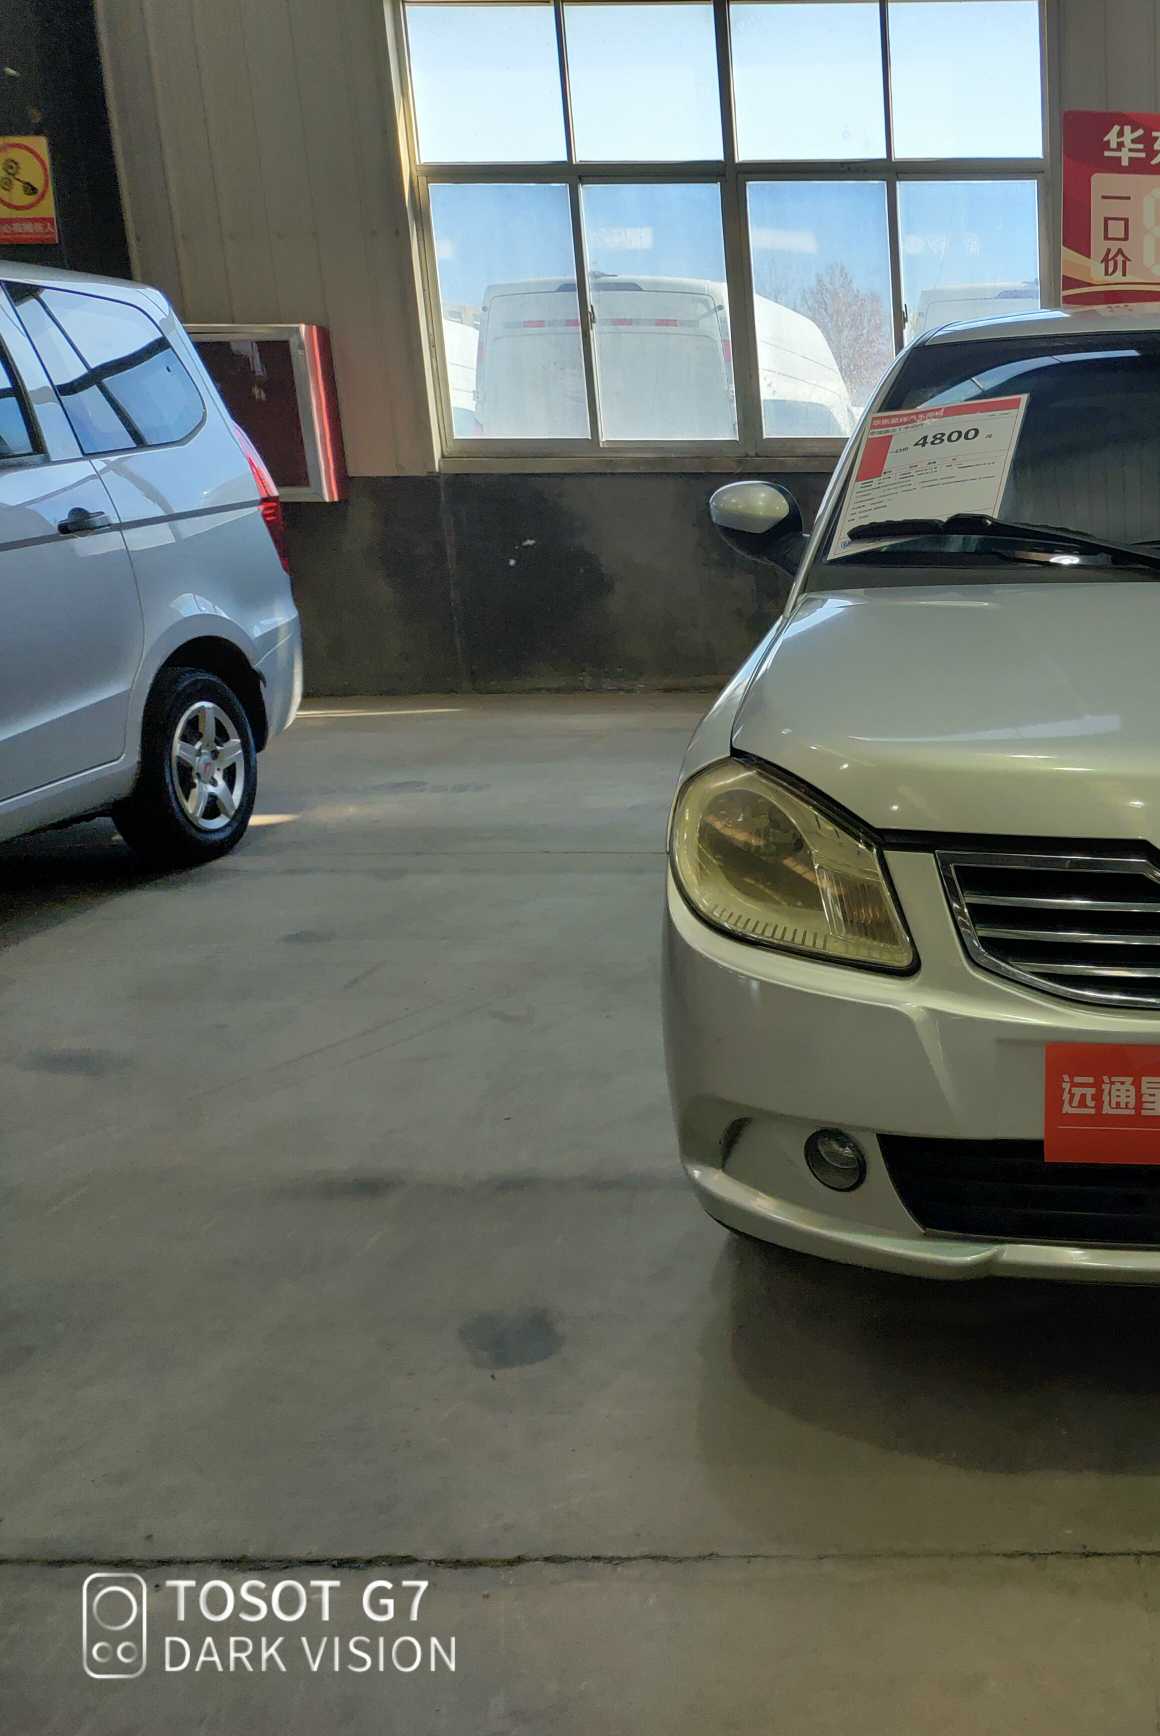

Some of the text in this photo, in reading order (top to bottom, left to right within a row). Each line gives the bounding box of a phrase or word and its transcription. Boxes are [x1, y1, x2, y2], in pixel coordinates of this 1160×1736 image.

[1100, 194, 1133, 279] 一口价
[913, 427, 980, 448] 4800
